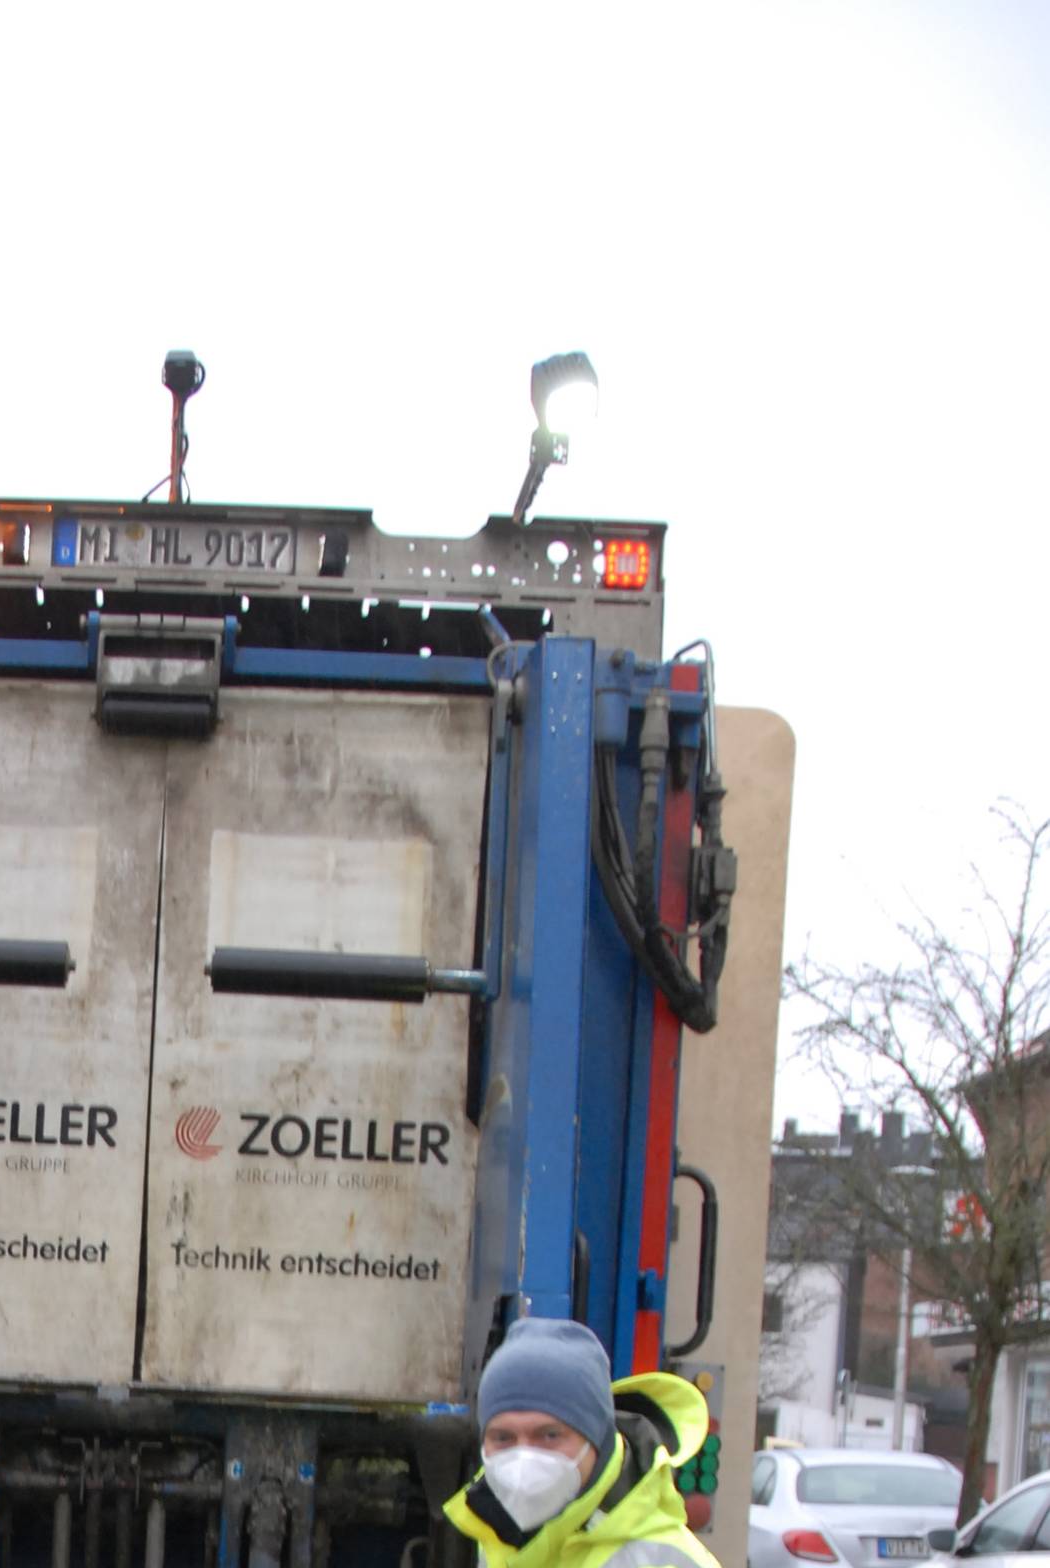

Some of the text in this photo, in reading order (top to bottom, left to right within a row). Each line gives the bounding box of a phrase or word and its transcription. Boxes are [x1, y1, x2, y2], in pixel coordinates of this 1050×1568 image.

[80, 525, 118, 562] MI
[150, 527, 192, 566] HL
[205, 527, 290, 569] 9017
[237, 1112, 451, 1165] ZOELLER
[5, 1154, 71, 1174] GRUPPE
[235, 1167, 328, 1188] KIRCHHOFF
[171, 1242, 442, 1281] Technik entscheidet
